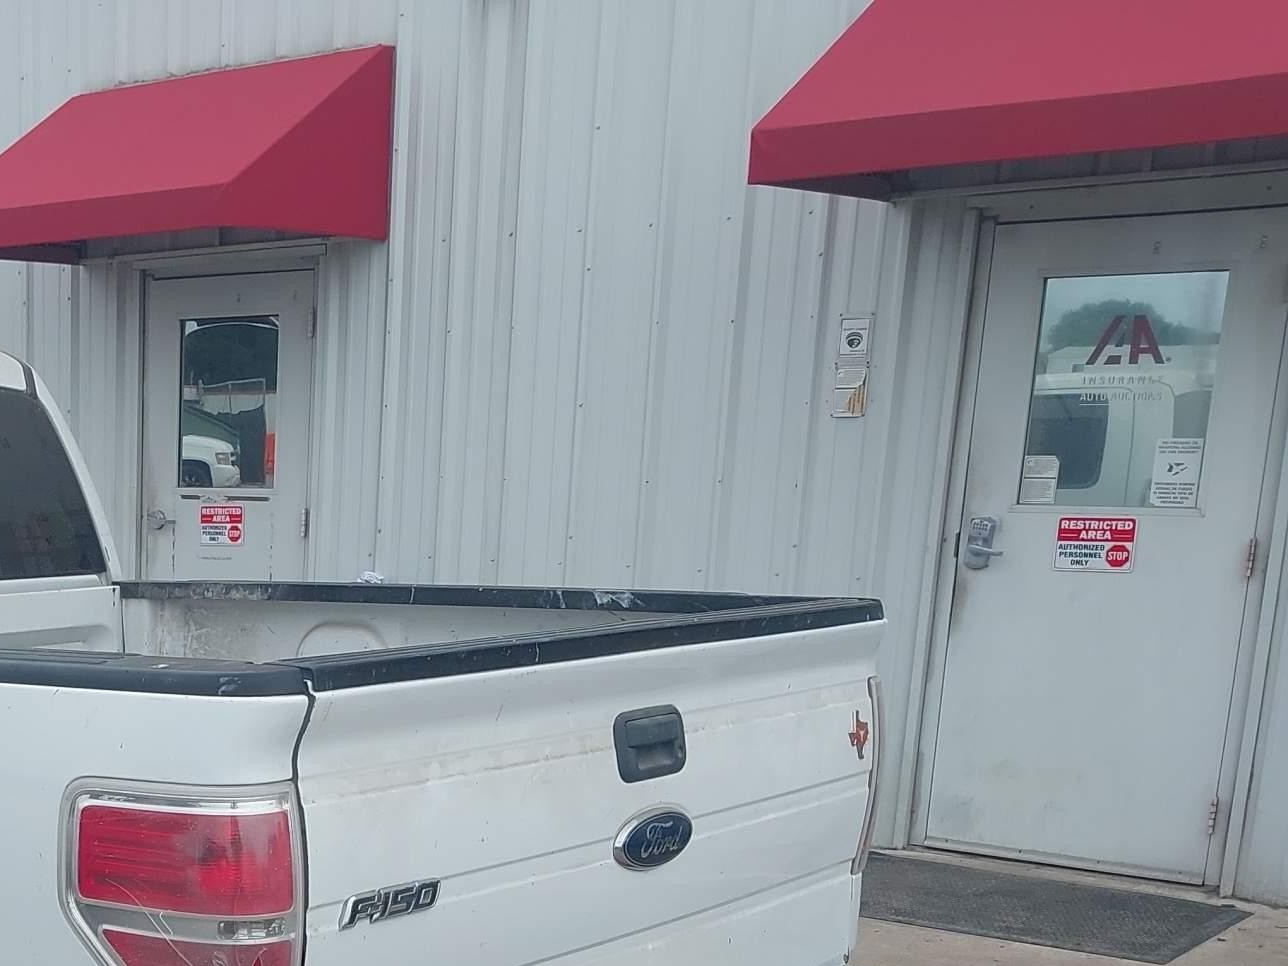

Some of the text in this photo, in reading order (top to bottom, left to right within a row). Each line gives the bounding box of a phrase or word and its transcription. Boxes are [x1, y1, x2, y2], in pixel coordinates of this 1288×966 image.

[1061, 520, 1134, 530] RESTRICTED
[1079, 530, 1111, 540] AREA
[1058, 551, 1102, 559] PERSONNEL
[1107, 551, 1128, 560] STOP
[640, 820, 683, 858] Ford
